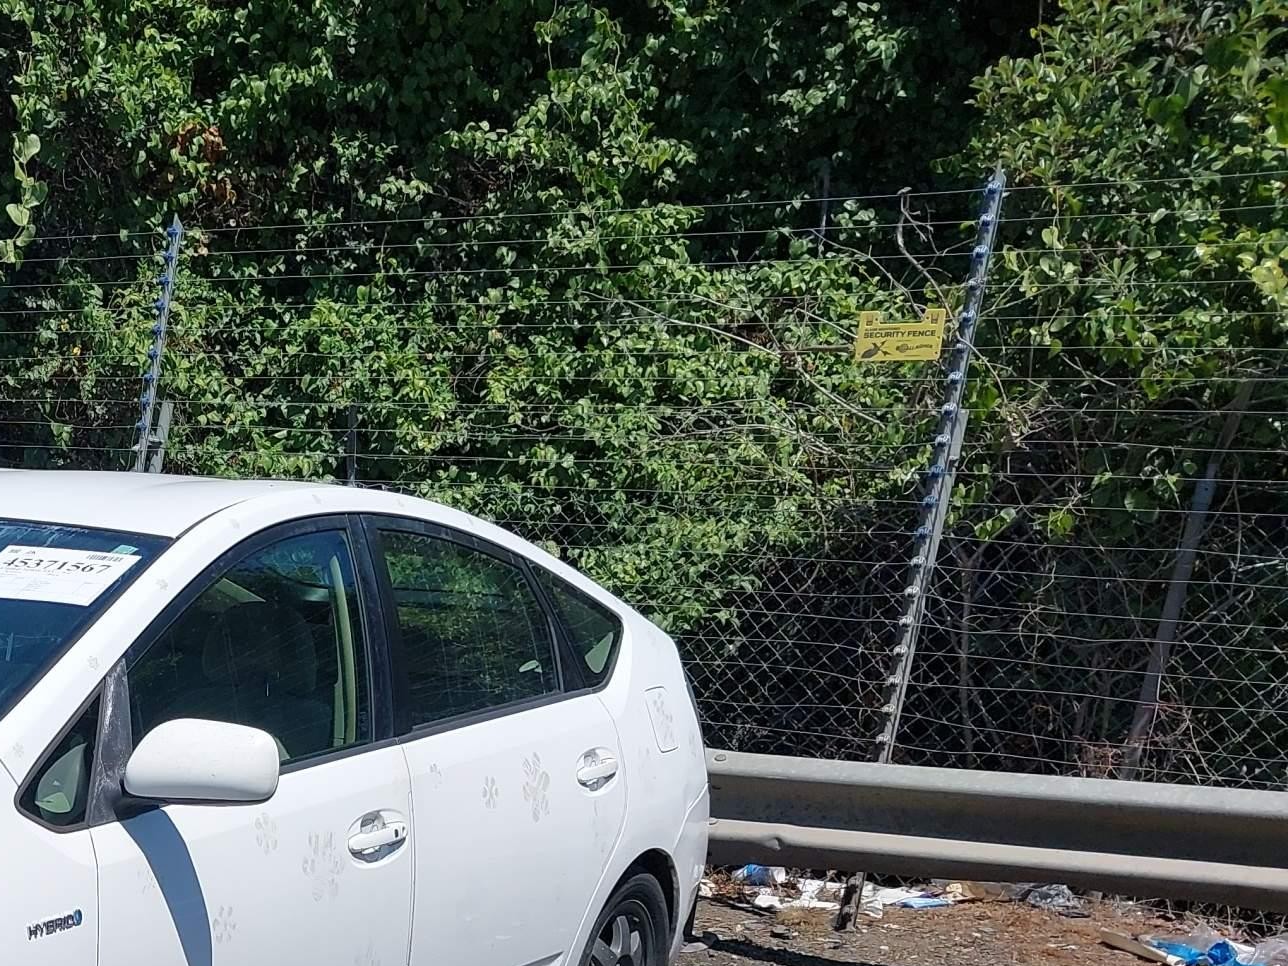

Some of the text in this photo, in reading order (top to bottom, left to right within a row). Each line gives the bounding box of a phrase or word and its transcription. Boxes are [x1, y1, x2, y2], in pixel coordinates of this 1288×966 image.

[863, 330, 906, 339] SECURITY
[907, 329, 936, 337] FENCE
[2, 557, 113, 575] 45371567
[27, 914, 75, 941] HYBRID
